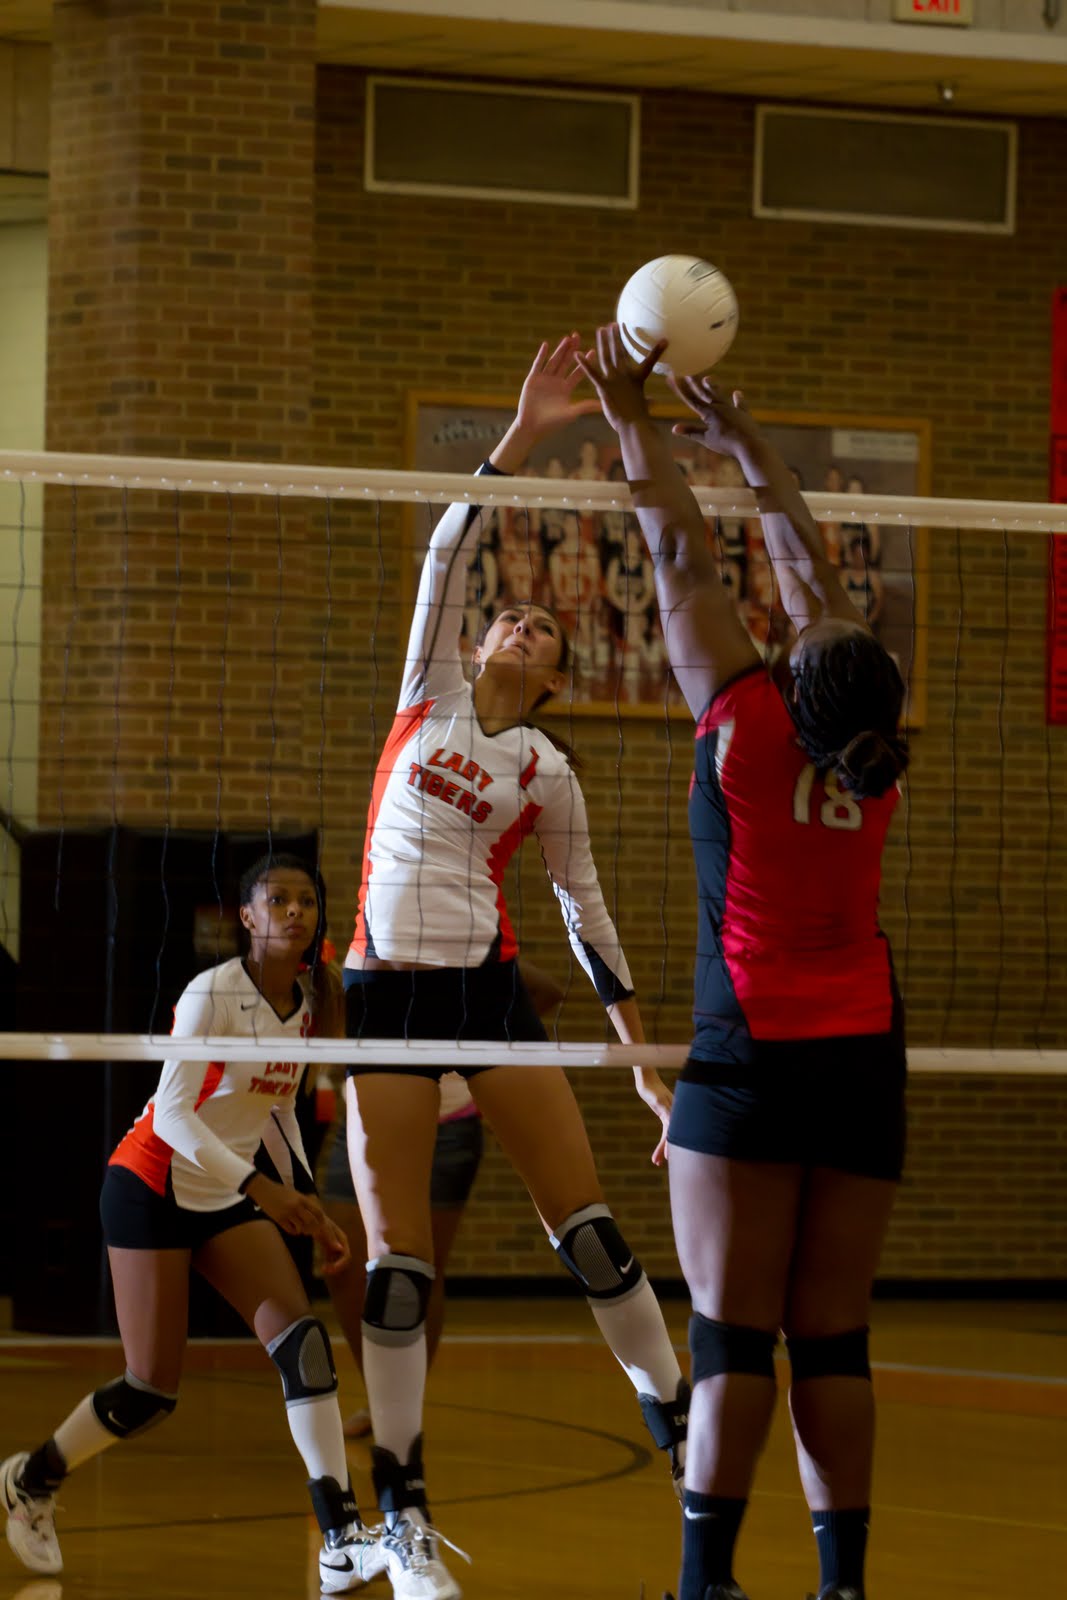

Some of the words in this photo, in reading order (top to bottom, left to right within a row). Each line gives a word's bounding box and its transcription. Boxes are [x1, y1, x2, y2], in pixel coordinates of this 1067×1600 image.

[407, 762, 493, 824] TIGERS
[426, 748, 494, 792] LADY
[793, 763, 863, 831] 18
